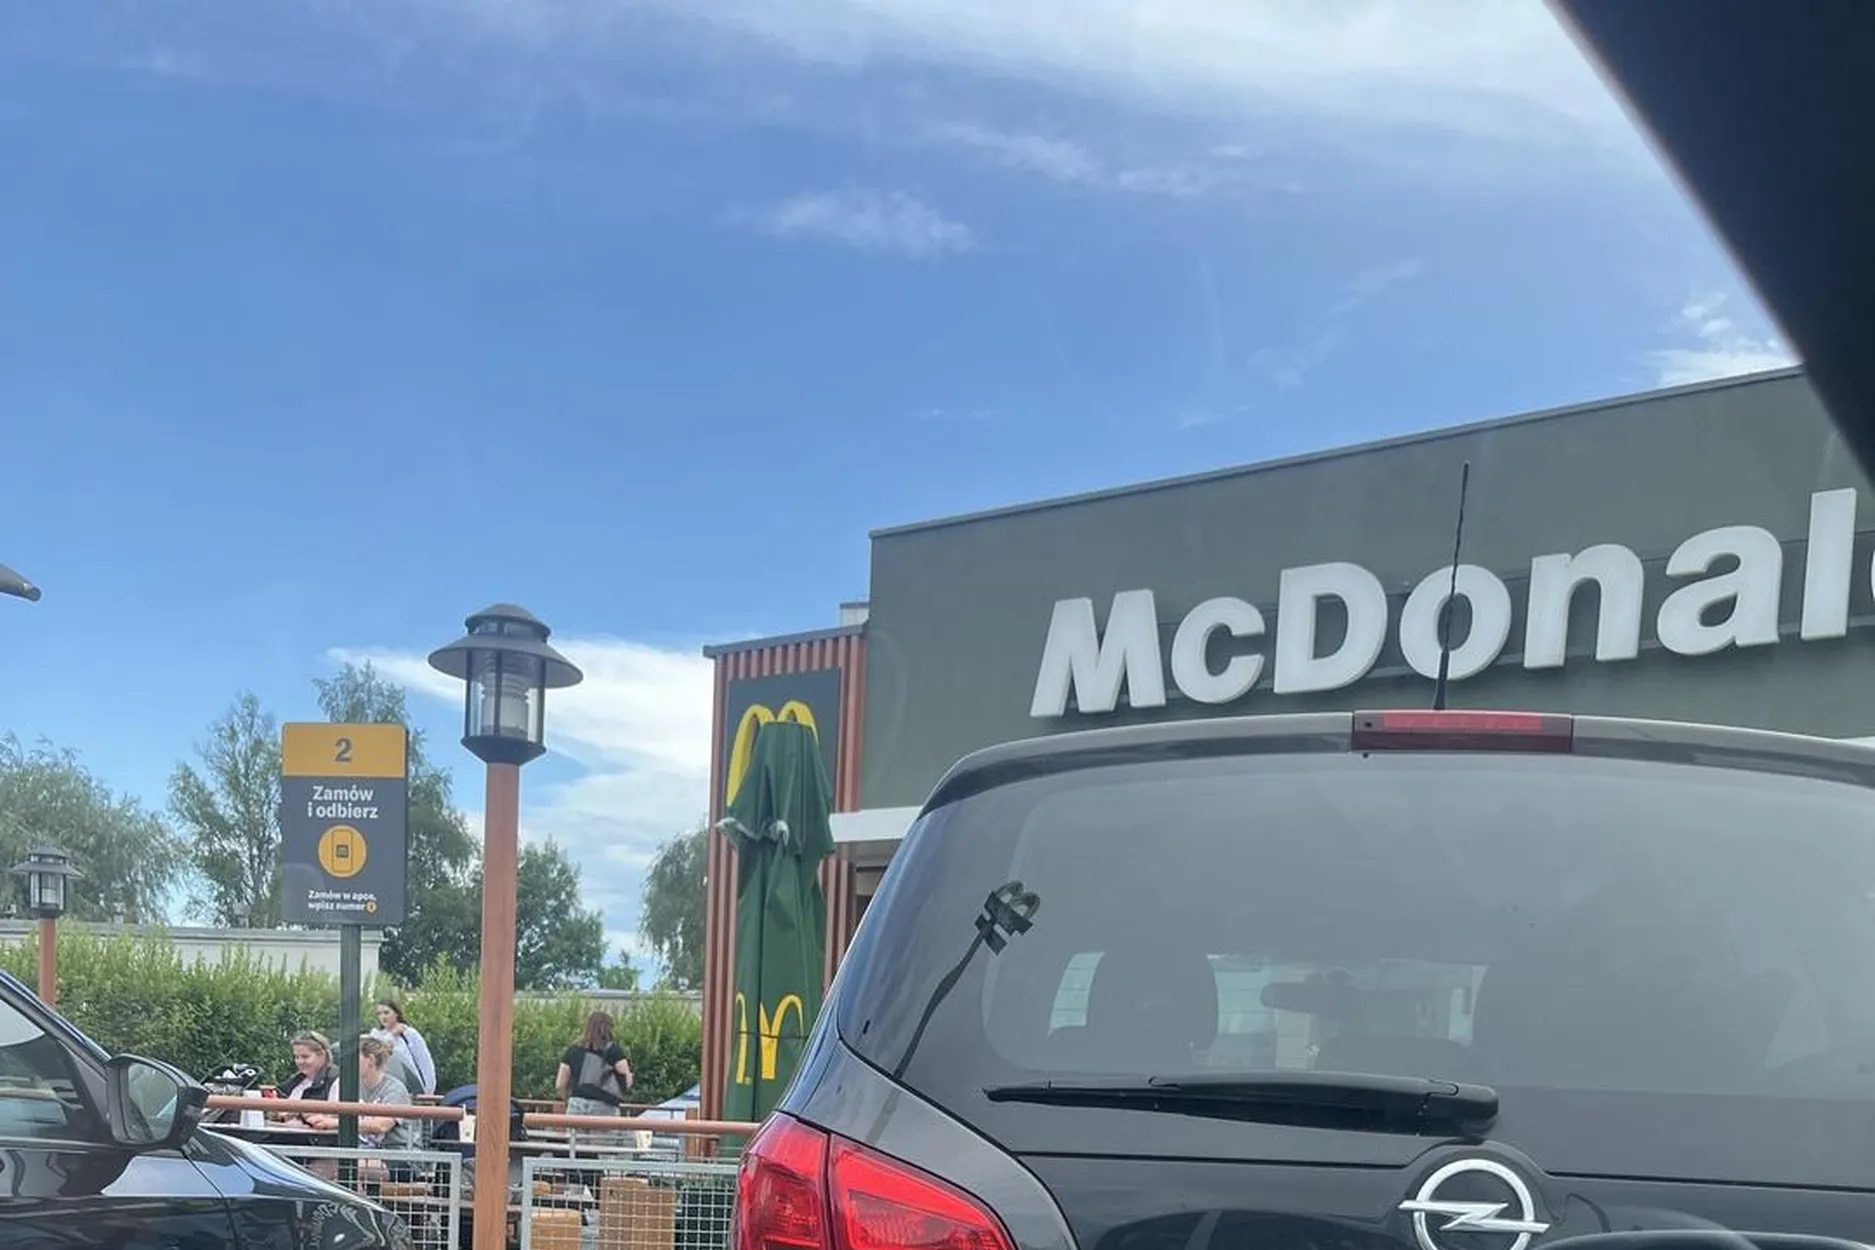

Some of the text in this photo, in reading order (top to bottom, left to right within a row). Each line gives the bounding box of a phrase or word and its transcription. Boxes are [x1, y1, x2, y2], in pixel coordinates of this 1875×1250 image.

[1030, 487, 1875, 718] McDonal
[334, 738, 353, 763] 2
[312, 785, 374, 801] Zamów
[308, 802, 379, 819] i odbierz
